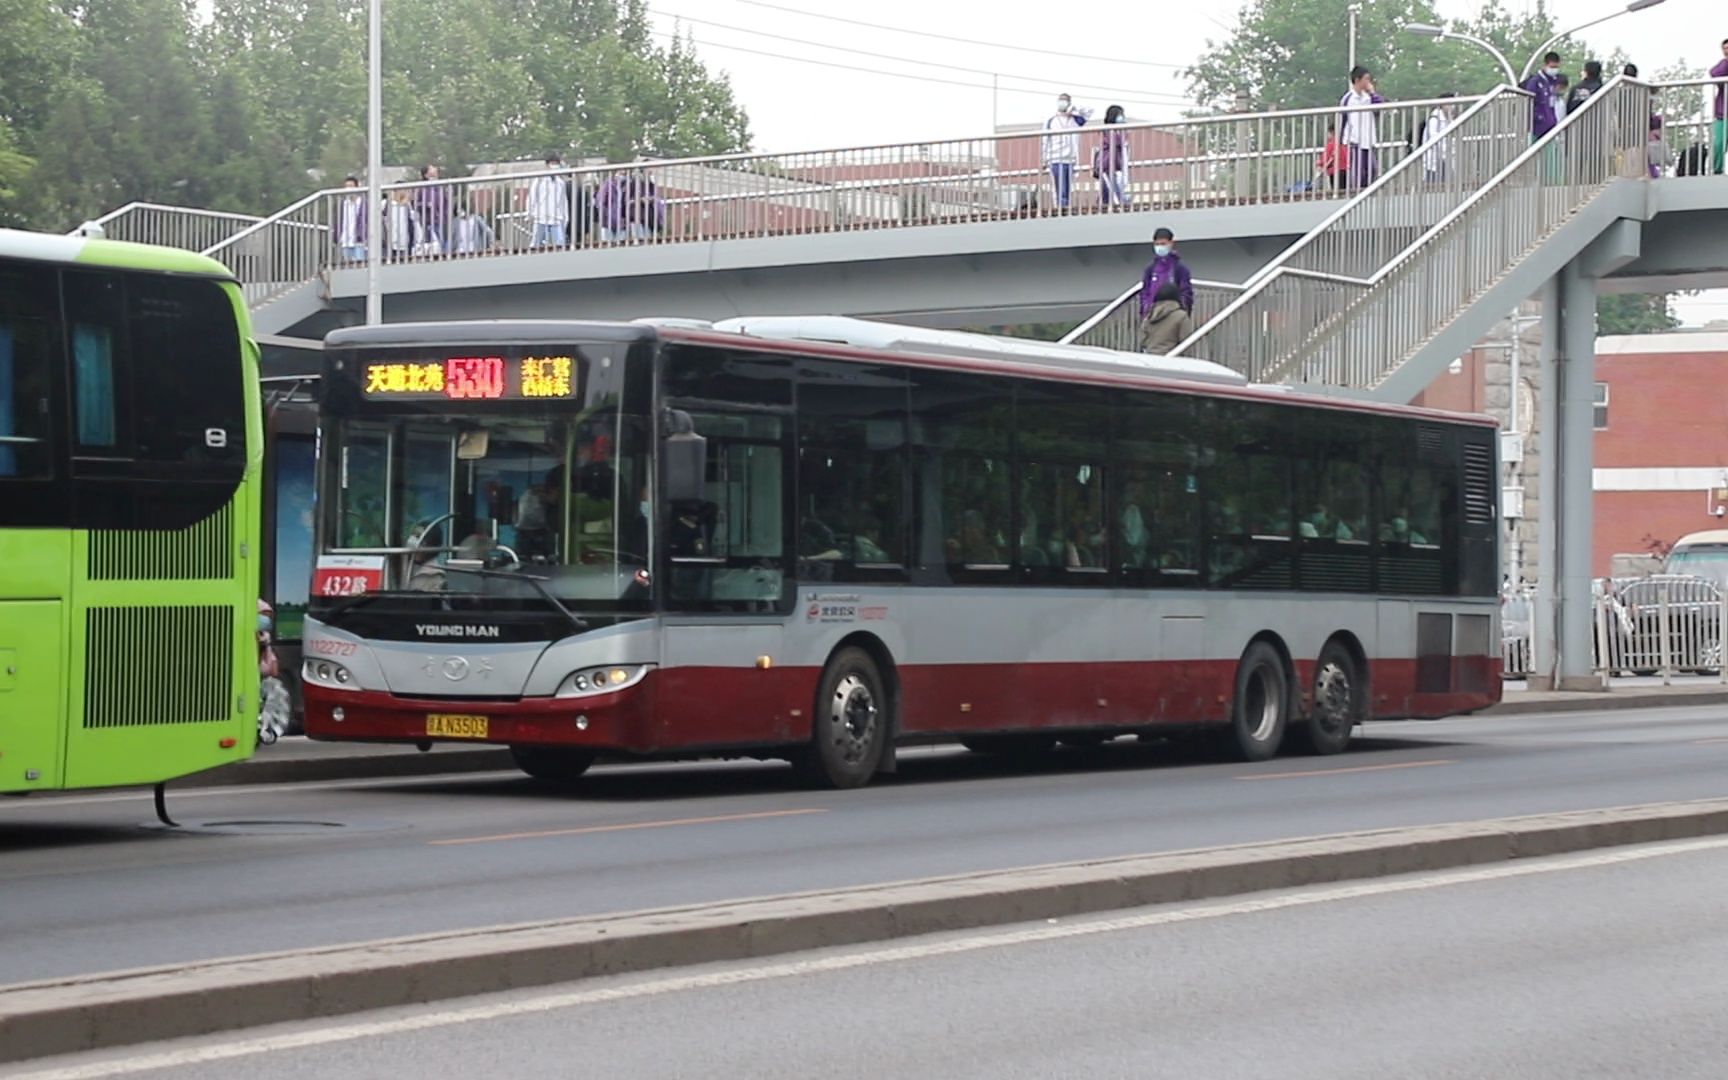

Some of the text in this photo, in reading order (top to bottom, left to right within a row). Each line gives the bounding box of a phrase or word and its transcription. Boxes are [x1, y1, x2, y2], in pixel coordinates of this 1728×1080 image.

[366, 358, 503, 397] 天通北苑 530
[416, 624, 500, 637] YOUNG MAN
[309, 639, 357, 656] 1122727
